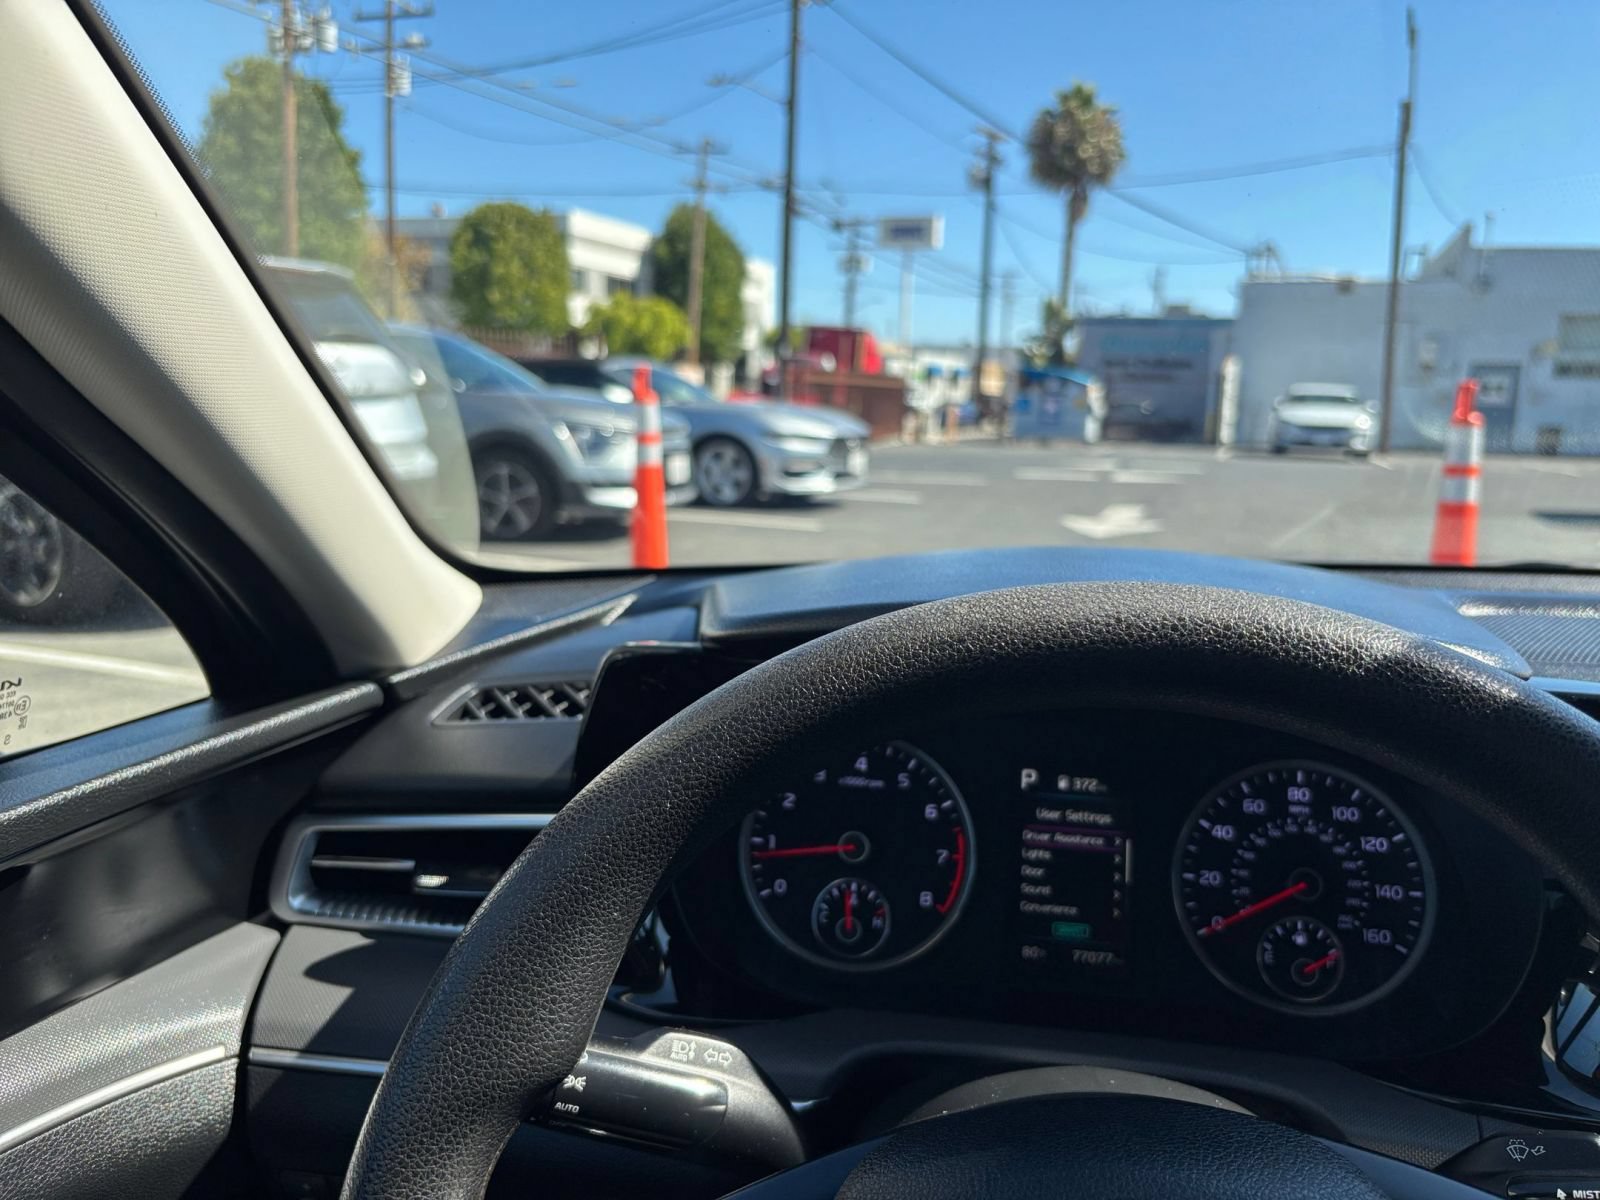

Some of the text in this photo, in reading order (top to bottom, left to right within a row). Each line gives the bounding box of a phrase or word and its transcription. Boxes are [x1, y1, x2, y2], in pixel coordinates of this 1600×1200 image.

[853, 756, 868, 772] 4
[897, 772, 911, 790] 5
[1020, 768, 1039, 790] P
[781, 792, 797, 809] 2
[1287, 786, 1312, 803] 80
[924, 803, 938, 820] 6
[1242, 798, 1267, 814] 60
[1332, 805, 1360, 823] 100
[1035, 807, 1112, 825] User Settings
[1210, 824, 1235, 841] 40
[767, 834, 776, 850] 1
[1360, 835, 1389, 853] 120
[936, 848, 950, 865] 7
[773, 878, 788, 895] 0
[1199, 869, 1223, 887] 20
[919, 890, 934, 908] 8
[1374, 883, 1404, 901] 140
[1362, 926, 1392, 945] 160
[670, 1052, 689, 1062] AUTO
[554, 1101, 580, 1113] AUTO
[1573, 1189, 1600, 1200] MIST
